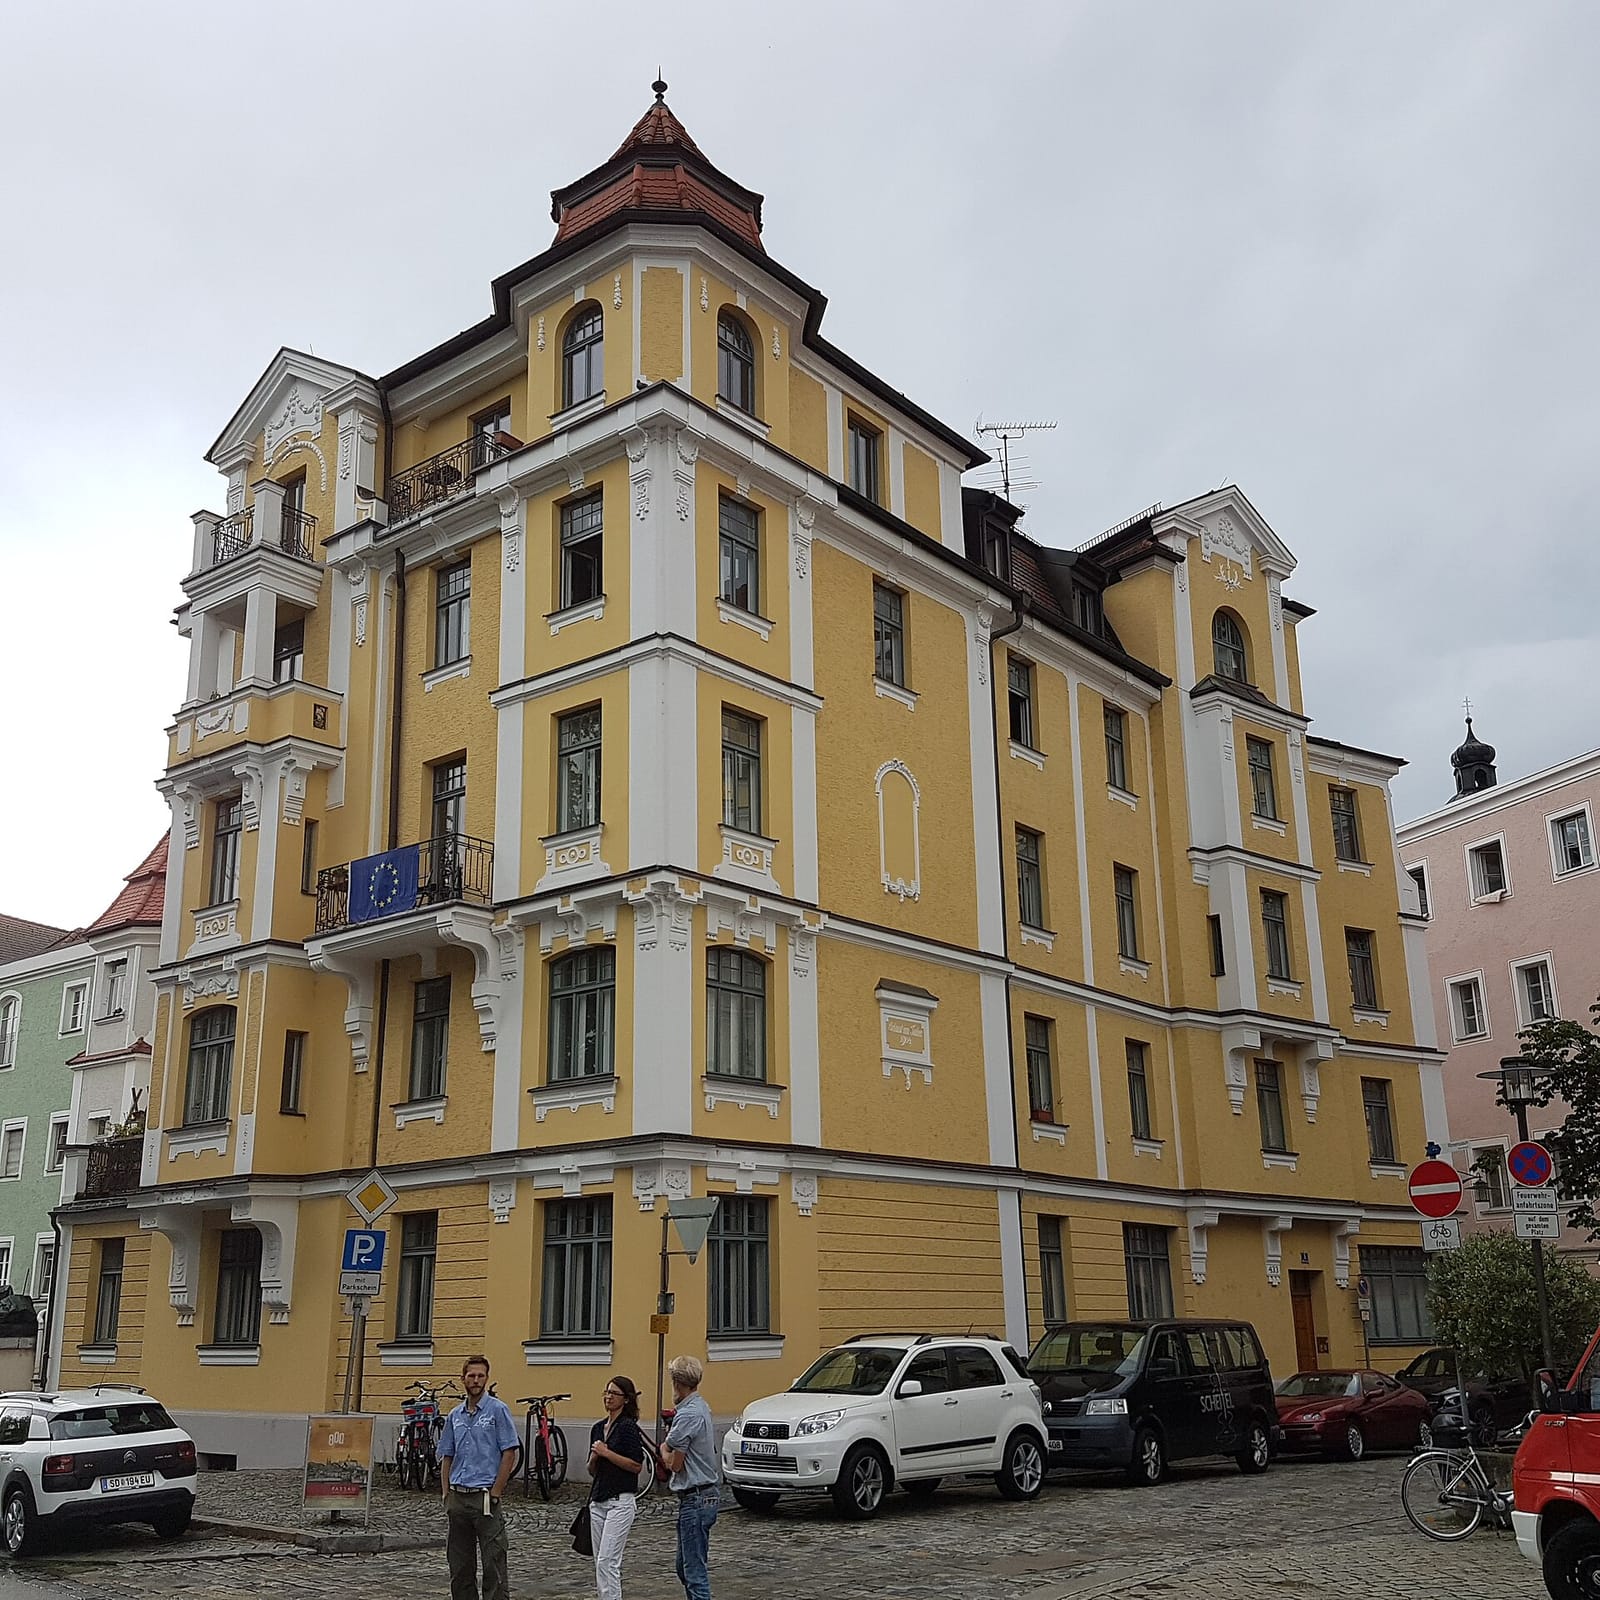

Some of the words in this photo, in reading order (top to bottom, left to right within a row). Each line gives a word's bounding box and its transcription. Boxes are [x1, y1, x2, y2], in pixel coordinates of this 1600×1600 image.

[1517, 1191, 1551, 1199] Feuerwehr-
[1516, 1201, 1554, 1209] anfahrtszone
[1436, 1239, 1449, 1248] frei
[352, 1235, 375, 1265] P
[328, 1431, 344, 1446] 800
[140, 1475, 151, 1485] EU
